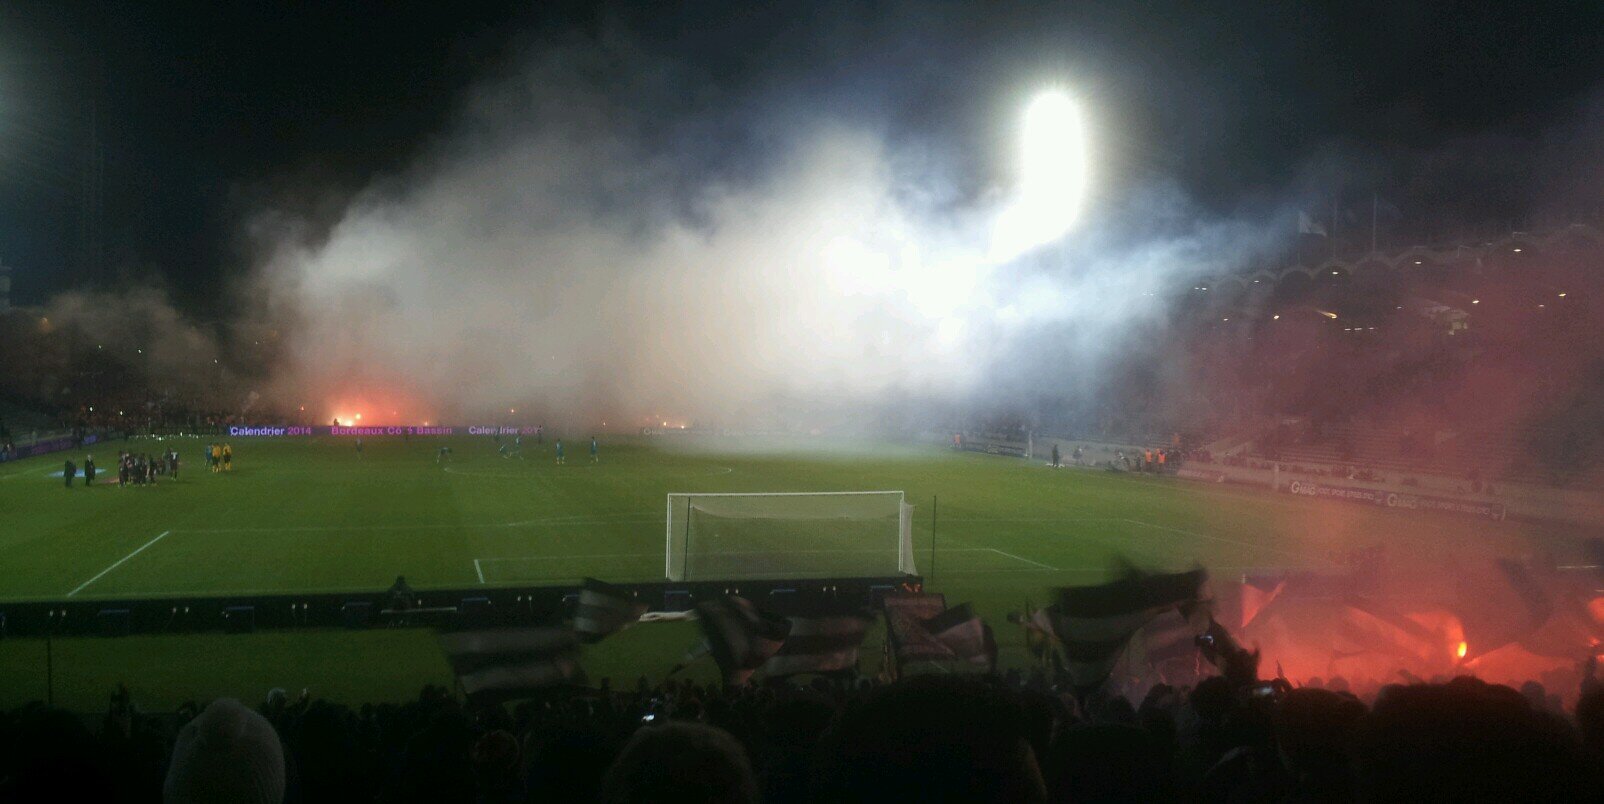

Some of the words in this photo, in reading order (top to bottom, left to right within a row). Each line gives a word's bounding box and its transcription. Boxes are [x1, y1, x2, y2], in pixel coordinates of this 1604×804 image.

[230, 426, 285, 436] Calendrier
[288, 426, 311, 436] 2014
[331, 426, 384, 436] Bordeaux
[417, 426, 452, 435] Bassin
